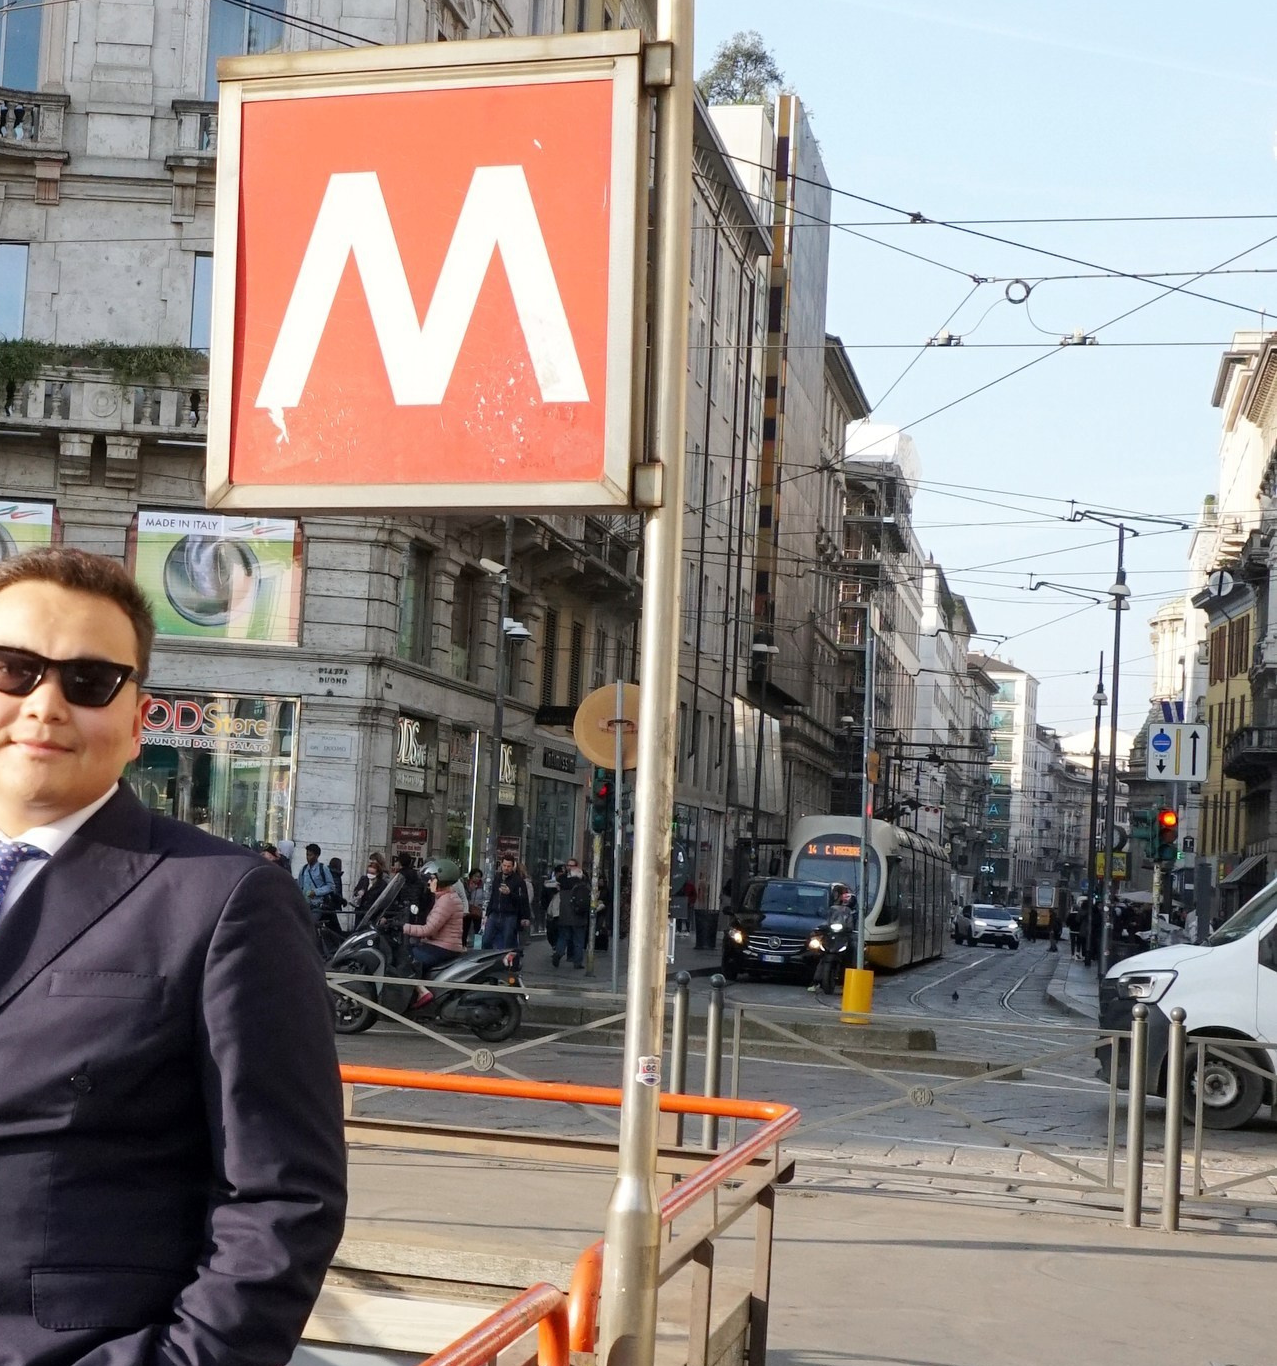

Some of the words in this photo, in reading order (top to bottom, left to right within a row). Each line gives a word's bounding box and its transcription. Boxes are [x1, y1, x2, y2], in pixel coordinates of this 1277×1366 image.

[255, 164, 590, 408] M
[145, 518, 176, 528] MADE
[178, 520, 191, 529] IN
[193, 521, 218, 530] ITALY
[318, 667, 348, 675] PIAZZA
[143, 698, 269, 736] ODStore
[140, 737, 191, 748] OVUNQUE
[229, 741, 270, 753] SALATO
[808, 844, 817, 853] 14
